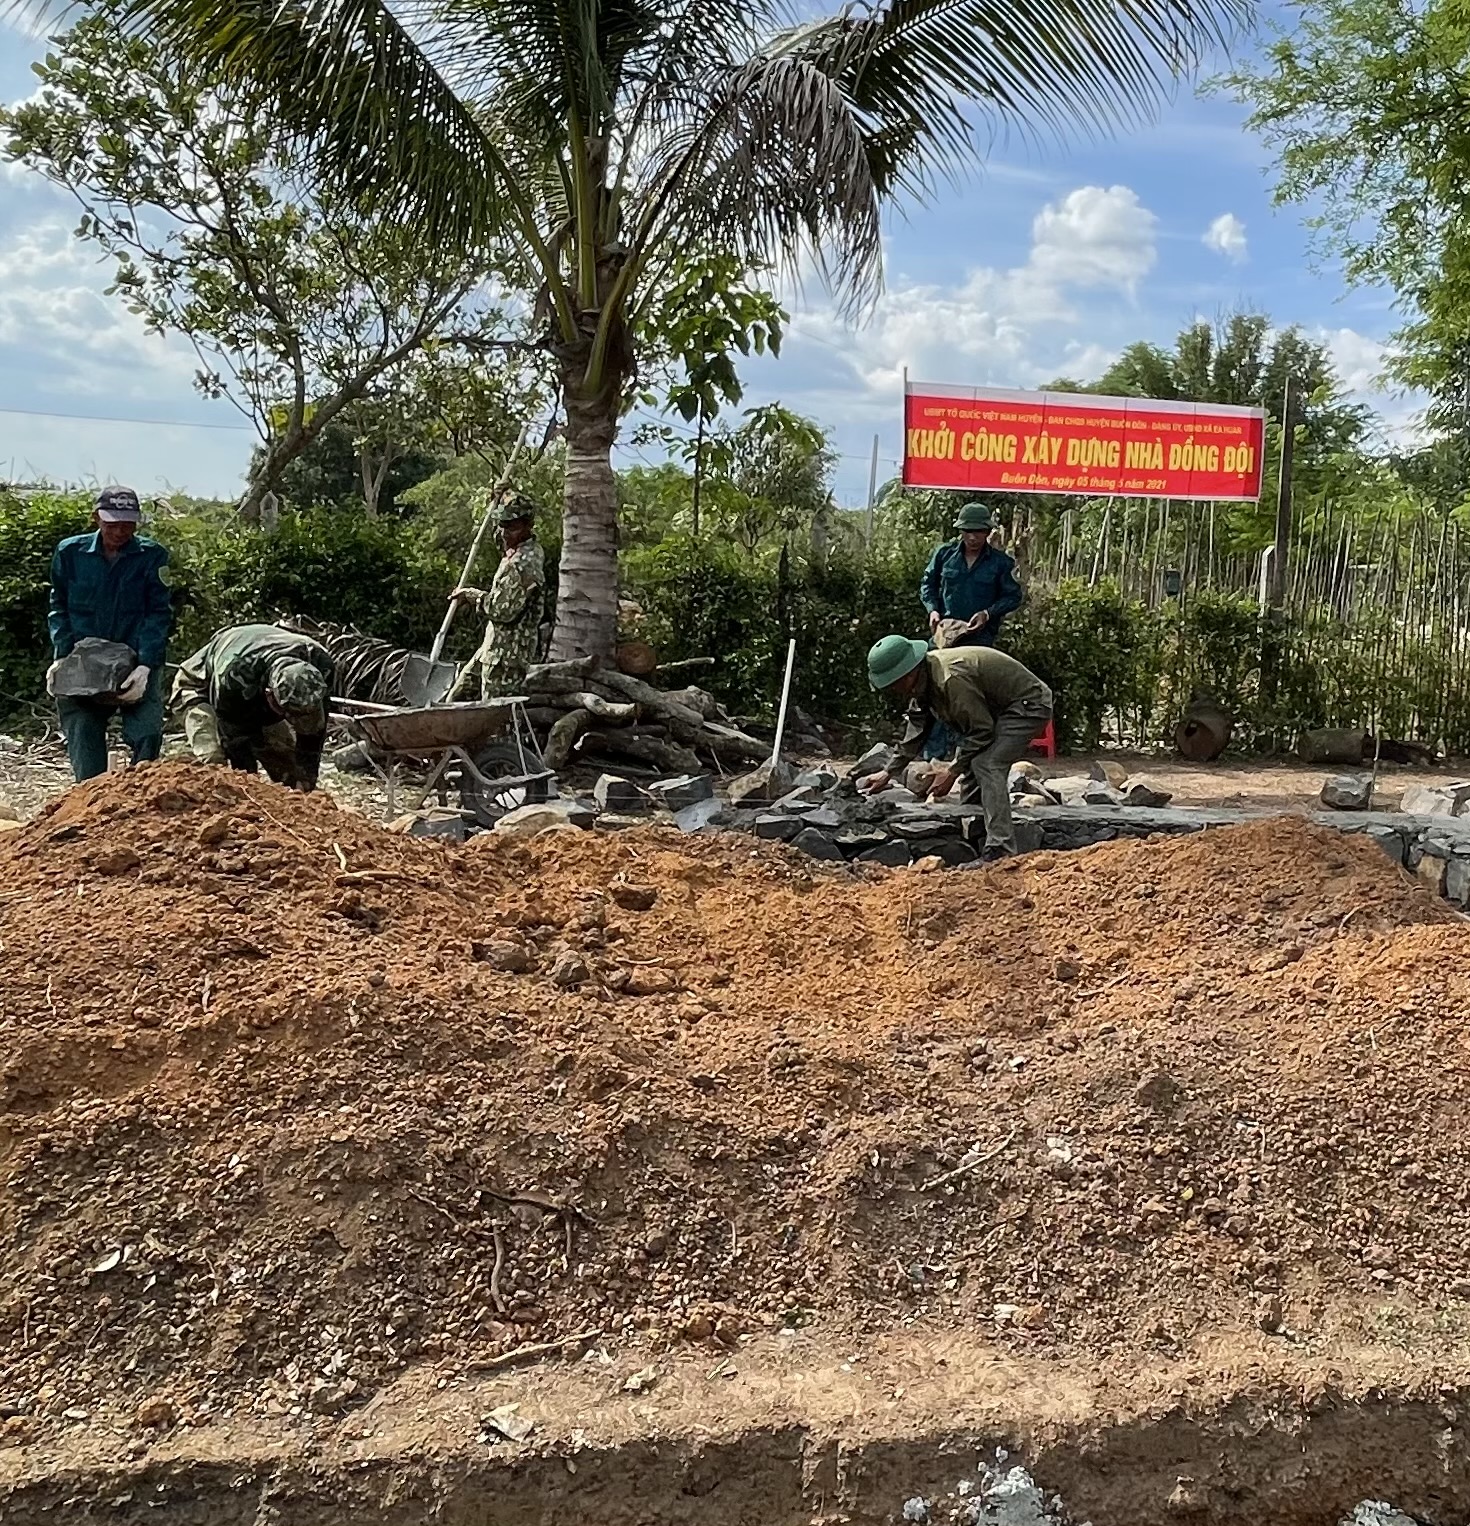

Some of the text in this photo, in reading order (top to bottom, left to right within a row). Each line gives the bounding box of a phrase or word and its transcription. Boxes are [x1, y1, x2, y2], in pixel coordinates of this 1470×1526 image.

[982, 410, 1000, 421] VIỆT
[1000, 412, 1017, 421] NAM
[1086, 417, 1110, 429] HUYỆN
[908, 420, 956, 460] KHỞI
[961, 426, 1018, 463] CÔNG
[1021, 430, 1063, 465] XÂY
[1066, 437, 1121, 473] DỰNG
[1124, 437, 1164, 470] NHÀ
[1223, 441, 1255, 479] ĐỘI
[1001, 472, 1027, 484] Buôn
[1028, 474, 1050, 486] Đôn,
[1051, 476, 1075, 488] ngày
[1076, 476, 1089, 487] 05
[1089, 476, 1116, 490] tháng
[1124, 478, 1144, 489] năm
[1146, 479, 1167, 490] 2021
